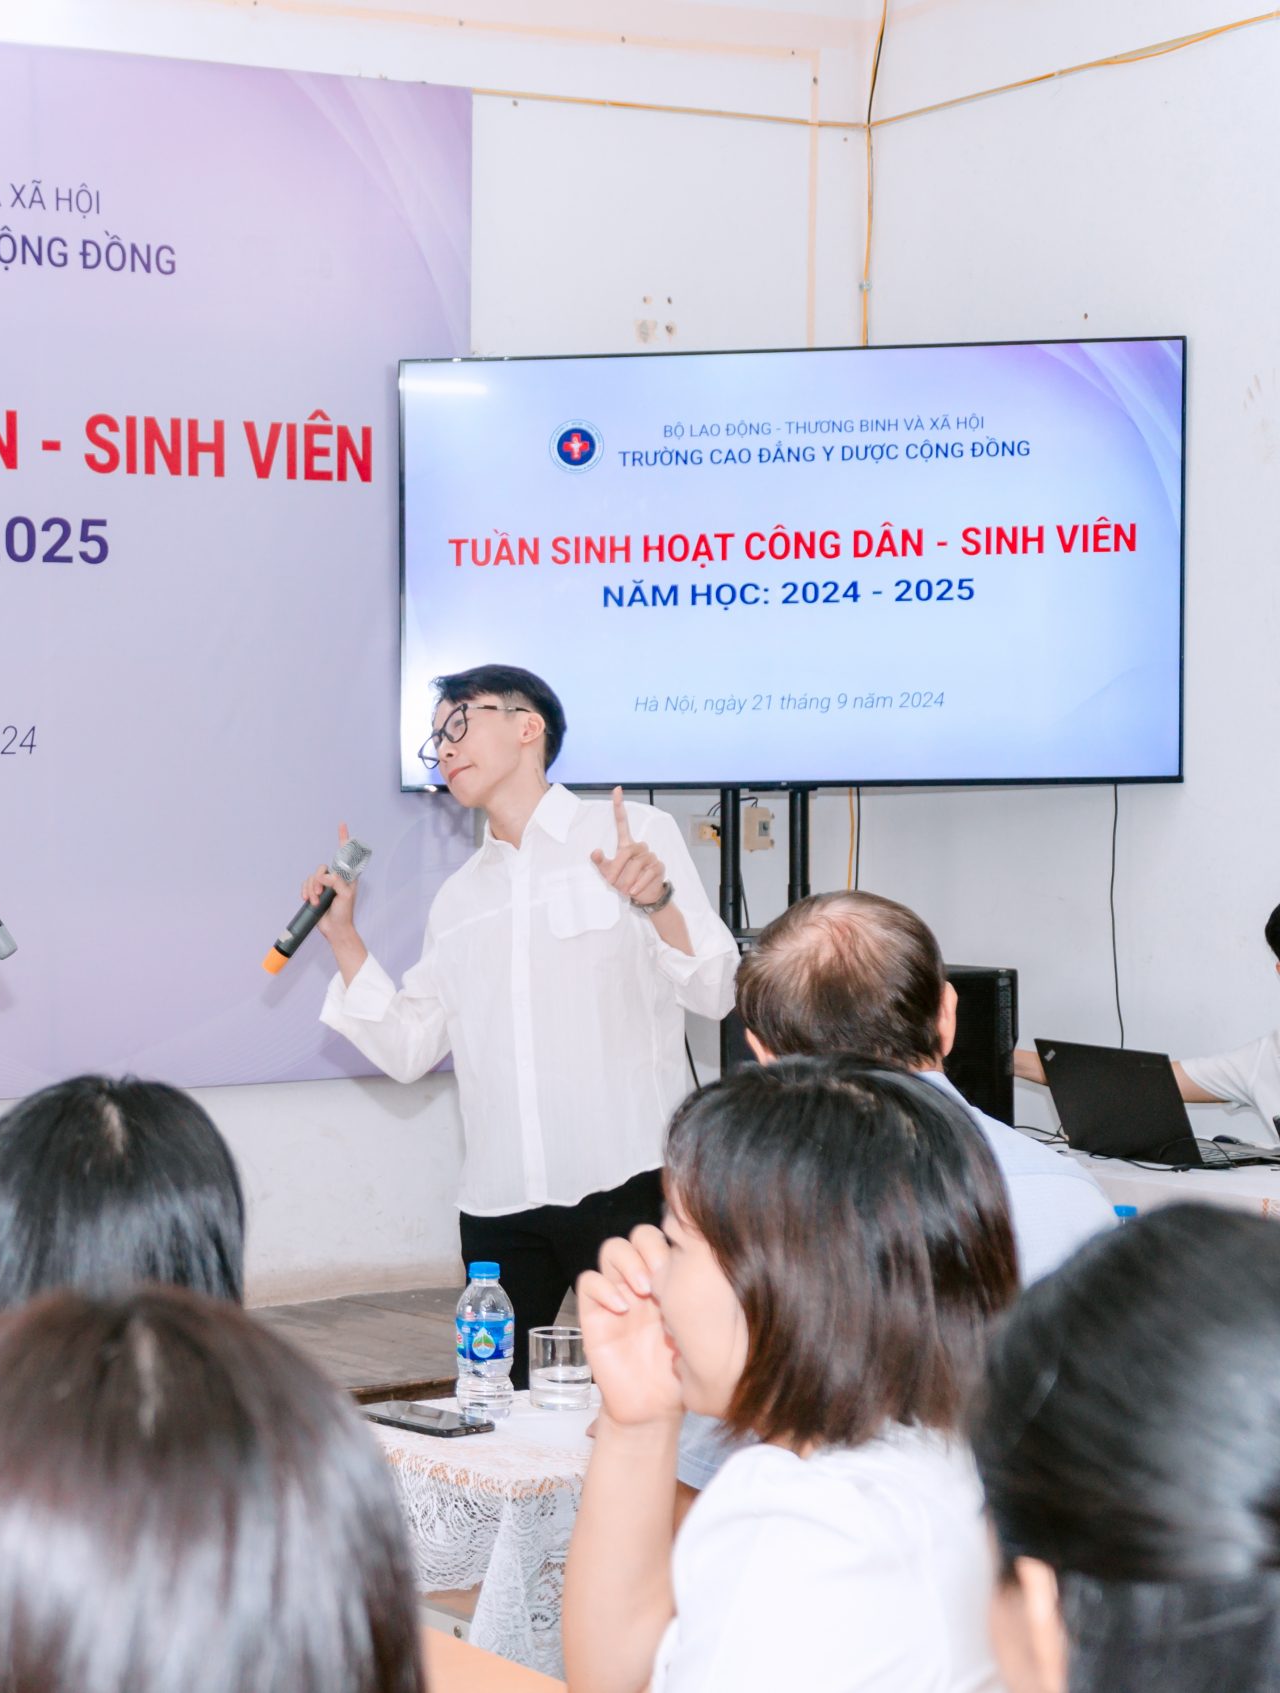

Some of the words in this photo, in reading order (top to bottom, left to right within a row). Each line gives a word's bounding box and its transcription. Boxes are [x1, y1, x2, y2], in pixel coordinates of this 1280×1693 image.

[10, 179, 46, 210] XÃ
[55, 183, 100, 219] HỘI
[79, 230, 176, 275] ĐỒNG
[664, 421, 685, 440] BỘ
[689, 424, 721, 439] LAO
[725, 420, 771, 440] ĐỘNG
[785, 419, 854, 435] THƯƠNG
[859, 418, 898, 432] BINH
[903, 415, 925, 431] VÀ
[929, 414, 951, 432] XÃ
[956, 413, 984, 432] HỘI
[41, 439, 62, 452] -
[84, 414, 225, 477] SINH
[243, 409, 372, 483] VIÊN
[618, 446, 703, 467] TRƯỜNG
[710, 448, 752, 465] CAO
[757, 440, 815, 463] ĐẲNG
[822, 445, 835, 462] Y
[841, 443, 899, 464] DƯỢC
[905, 439, 964, 462] CỘNG
[970, 436, 1030, 458] ĐỒNG
[448, 528, 540, 567] TUẦN
[551, 535, 631, 565] SINH
[643, 532, 735, 567] HOẠT
[744, 524, 841, 561] CÔNG
[853, 521, 924, 559] DÂN
[961, 525, 1045, 556] SINH
[1056, 516, 1136, 554] VIÊN
[603, 578, 679, 608] NĂM
[691, 582, 769, 611] HỌC:
[781, 580, 861, 604] 2024
[894, 578, 974, 602] 2025
[635, 694, 659, 712] Hà
[664, 695, 697, 714] Nội,
[704, 694, 747, 715] ngày
[752, 694, 772, 710] 21
[780, 693, 831, 714] tháng
[837, 693, 847, 709] 9
[853, 693, 893, 709] năm
[898, 691, 944, 708] 2024
